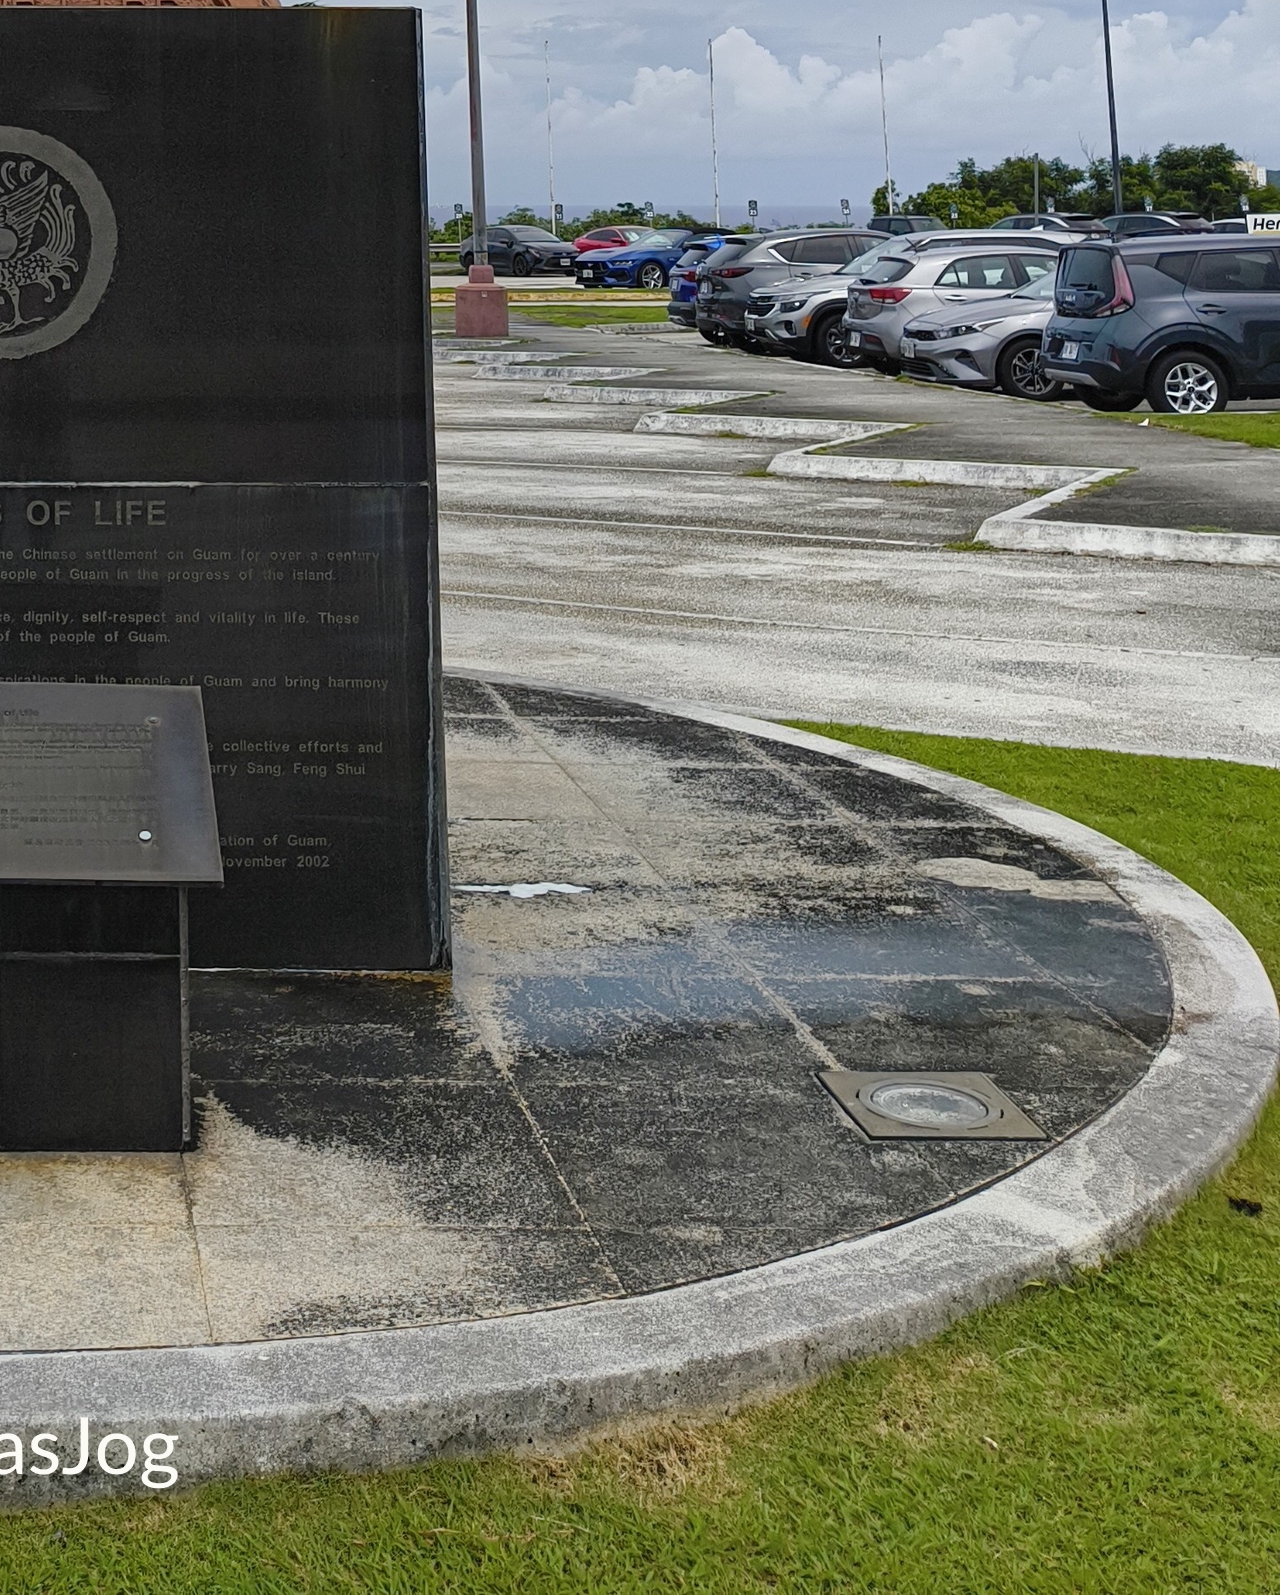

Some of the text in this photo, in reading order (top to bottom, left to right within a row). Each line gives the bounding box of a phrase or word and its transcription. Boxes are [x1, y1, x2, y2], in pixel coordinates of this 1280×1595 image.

[25, 500, 72, 525] OF
[94, 500, 168, 525] LIFE
[21, 549, 78, 561] Chinese
[85, 549, 158, 561] settlement
[166, 551, 184, 561] on
[192, 549, 232, 561] Guam
[240, 549, 261, 561] for
[269, 551, 302, 561] over
[45, 569, 62, 581] of
[69, 569, 110, 581] Guam
[116, 569, 130, 581] in
[136, 569, 160, 581] the
[166, 571, 231, 585] progress
[238, 569, 255, 581] of
[22, 611, 75, 627] dignity,
[81, 611, 167, 627] self-respect
[174, 611, 200, 624] and
[208, 611, 256, 627] vitality
[264, 611, 277, 624] in
[283, 611, 310, 624] life.
[318, 611, 360, 624] These
[18, 631, 42, 643] the
[48, 631, 96, 647] people
[103, 631, 120, 643] of
[127, 631, 171, 643] Guam.
[180, 675, 195, 686] of
[203, 675, 244, 688] Guam
[250, 675, 277, 688] and
[284, 675, 321, 692] bring
[327, 675, 389, 692] harmony
[222, 740, 291, 753] collective
[298, 740, 350, 753] efforts
[357, 740, 384, 753] and
[246, 762, 285, 778] Sang,
[292, 762, 328, 778] Feng
[335, 762, 366, 775] Shui
[262, 834, 279, 847] of
[286, 834, 332, 848] Guam,
[296, 855, 330, 868] 2002
